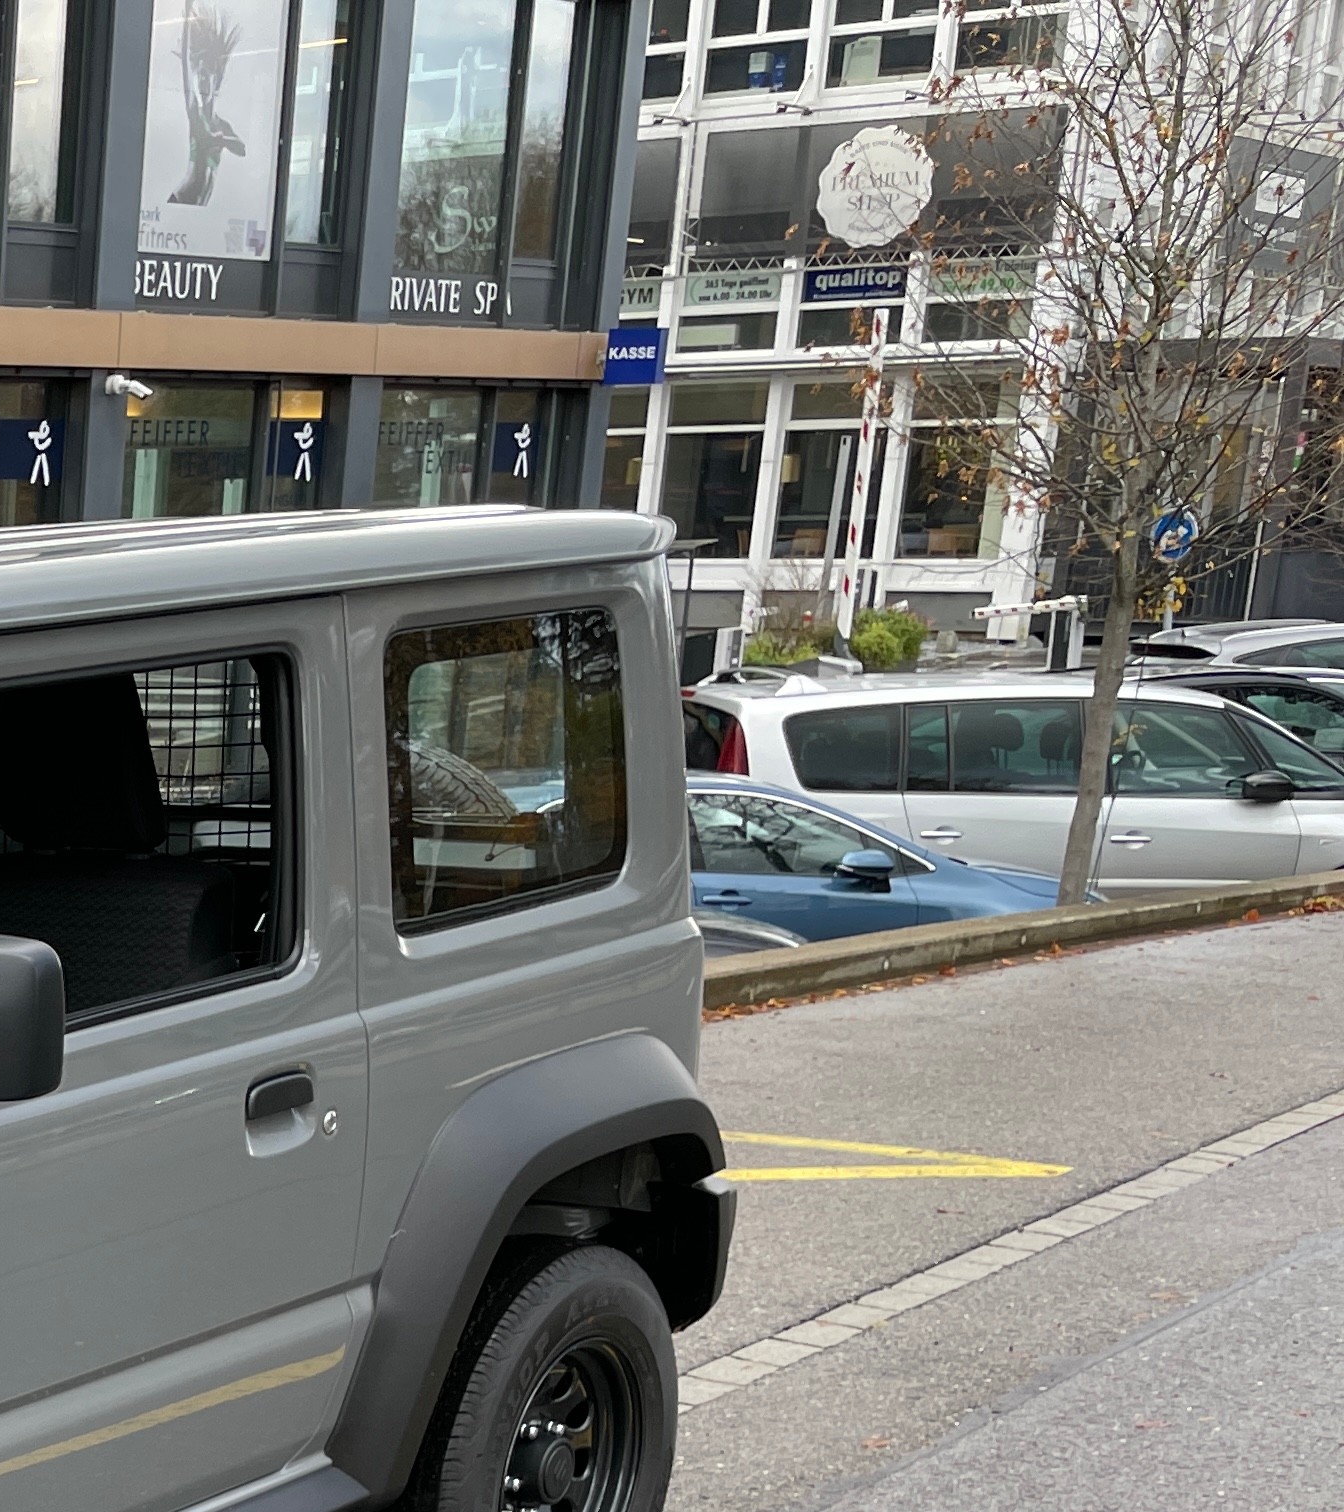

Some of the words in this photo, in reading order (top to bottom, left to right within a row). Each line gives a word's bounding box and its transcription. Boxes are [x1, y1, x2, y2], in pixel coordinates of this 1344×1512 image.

[139, 222, 188, 251] fitness
[815, 268, 902, 292] qualitop
[473, 281, 512, 316] SP
[608, 345, 656, 360] KASSE
[129, 419, 210, 447] FEIFFER
